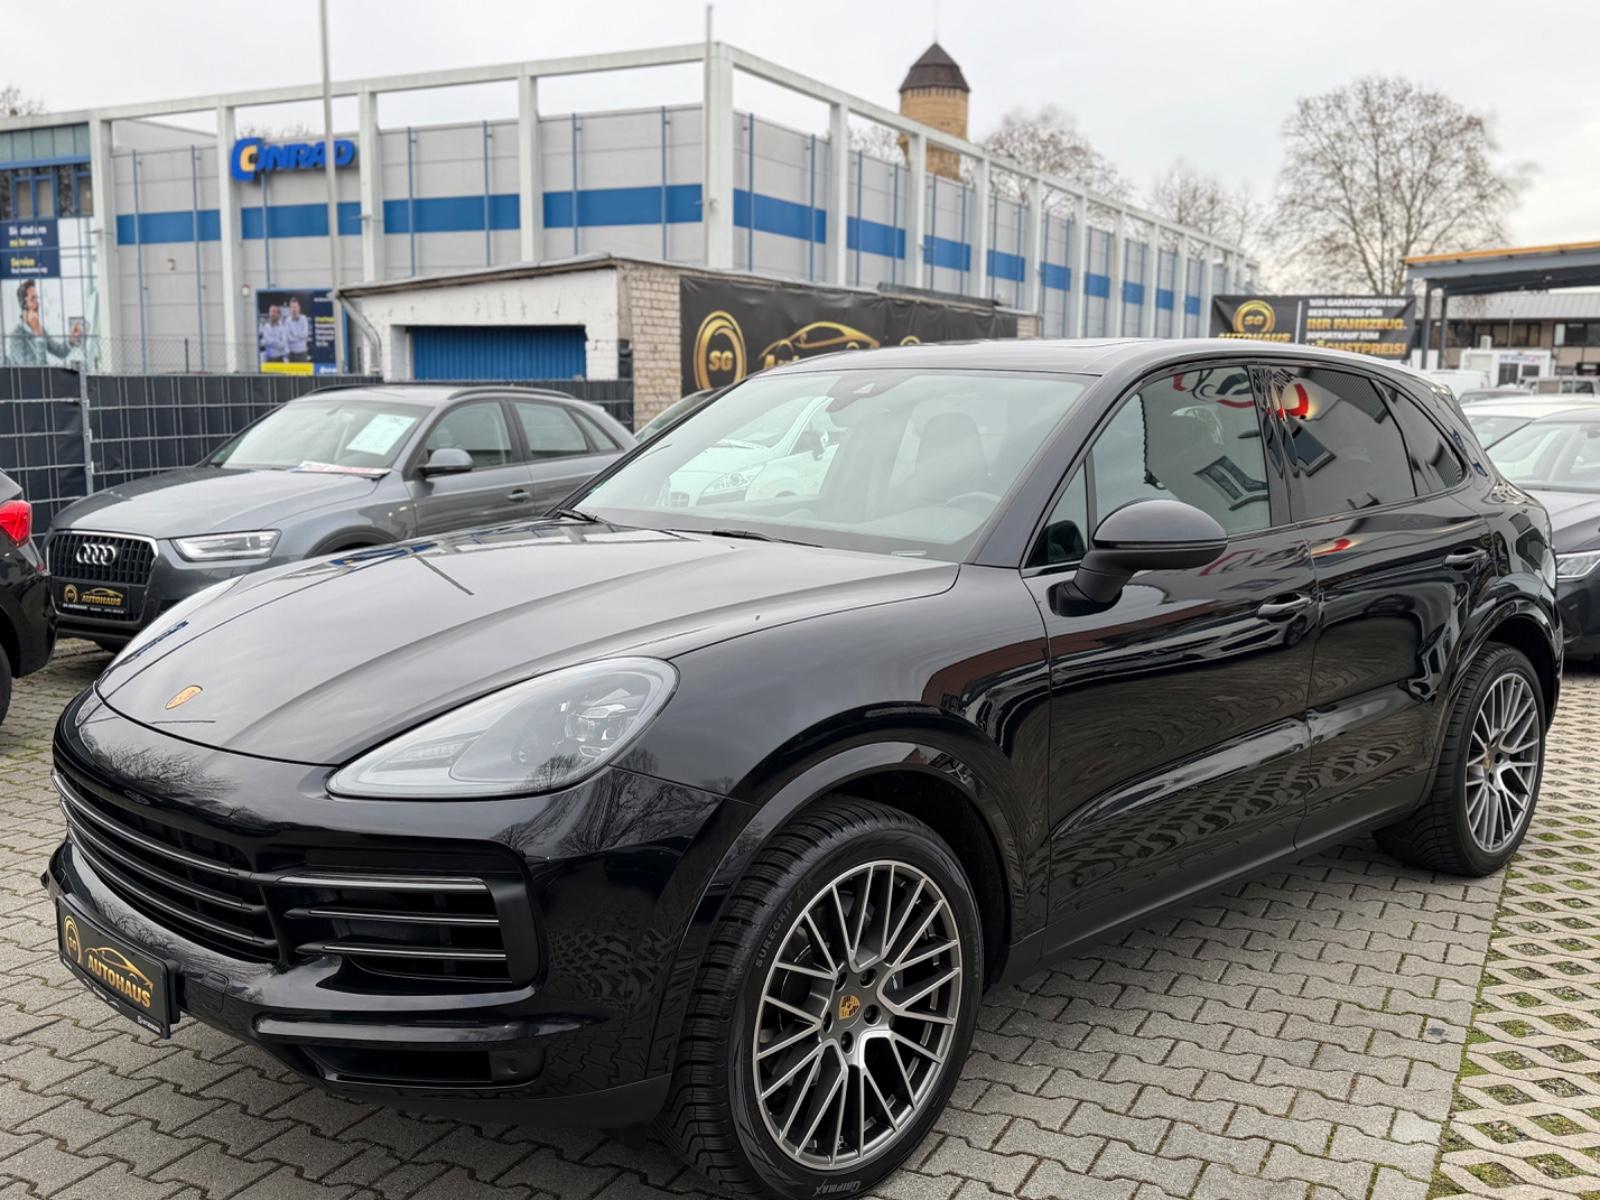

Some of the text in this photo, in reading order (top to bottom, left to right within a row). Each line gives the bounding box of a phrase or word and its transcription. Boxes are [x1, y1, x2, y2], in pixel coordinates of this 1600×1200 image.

[230, 137, 356, 182] CONRAD
[1327, 298, 1386, 307] GARANTIEREN
[1387, 298, 1406, 307] DEN
[1307, 306, 1383, 317] BESTEN PREIS FÜR
[1306, 318, 1408, 330] IHR FAHRZEUG.
[1359, 331, 1380, 340] ZUM
[709, 350, 733, 371] SG
[755, 899, 793, 968] SUREGRIP
[87, 953, 151, 1008] AUTOHAUS
